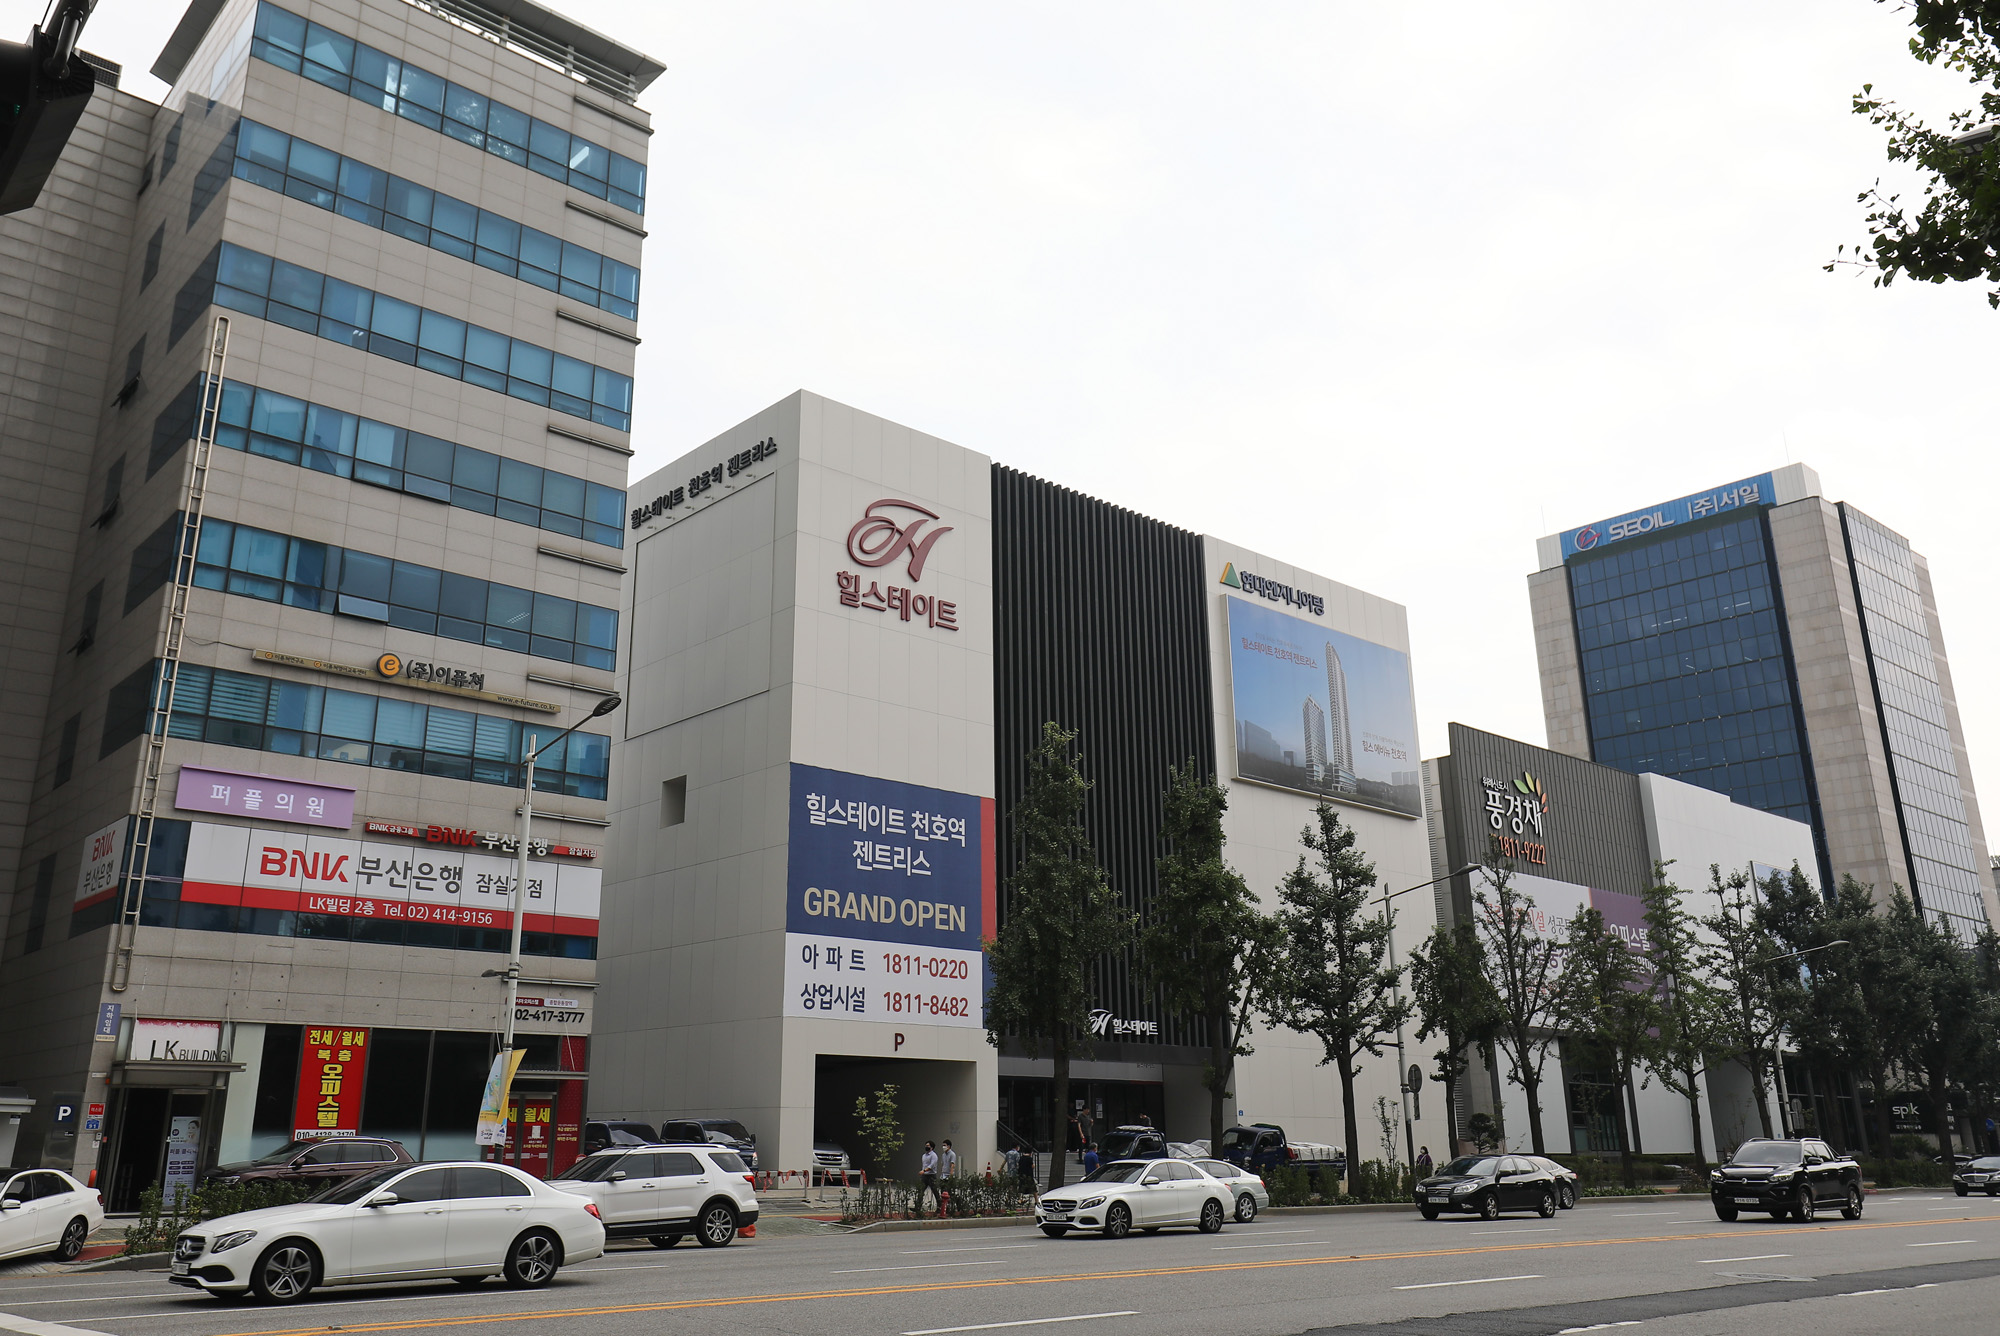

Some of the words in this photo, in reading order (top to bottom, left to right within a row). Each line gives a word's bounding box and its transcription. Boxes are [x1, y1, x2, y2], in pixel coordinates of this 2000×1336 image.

[630, 486, 684, 530] 힐스테이트
[687, 462, 723, 498] 천호역
[727, 436, 777, 476] 젠트리스
[1610, 511, 1675, 542] SEOIL
[836, 570, 959, 632] 힐스테이트
[1240, 570, 1325, 616] 현대엔지니어링
[1241, 637, 1273, 655] 힐스테이트
[1274, 647, 1293, 663] 천호역
[1293, 653, 1318, 669] 젠트리스
[497, 695, 556, 711] www.e-future.co.kr
[806, 792, 906, 836] 힐스테이트
[911, 810, 966, 847] 천호역
[1485, 789, 1543, 838] 풍경채
[91, 830, 116, 862] BNK
[426, 825, 478, 847] BNK
[1499, 836, 1546, 865] 1811-9222
[260, 846, 349, 884] BNK
[356, 855, 464, 895] 부산은행
[852, 840, 931, 876] 젠트리스
[83, 859, 114, 895] 부산은행
[309, 897, 351, 913] LK빌딩
[354, 901, 375, 915] 2층
[383, 903, 404, 917] Tel.
[408, 905, 429, 920] 02)
[433, 909, 493, 925] 414-9156
[803, 887, 896, 925] GRAND
[900, 899, 966, 932] OPEN
[883, 952, 968, 980] 1811-0220
[800, 983, 866, 1013] 상업시설
[883, 991, 969, 1017] 1811-8482
[515, 1009, 585, 1023] 02-417-3777
[1112, 1018, 1158, 1036] 힐스테이트
[150, 1040, 179, 1060] LK
[309, 1030, 365, 1047] 전세/월세
[317, 1063, 344, 1128] 오피스텔
[524, 1107, 551, 1123] 월세
